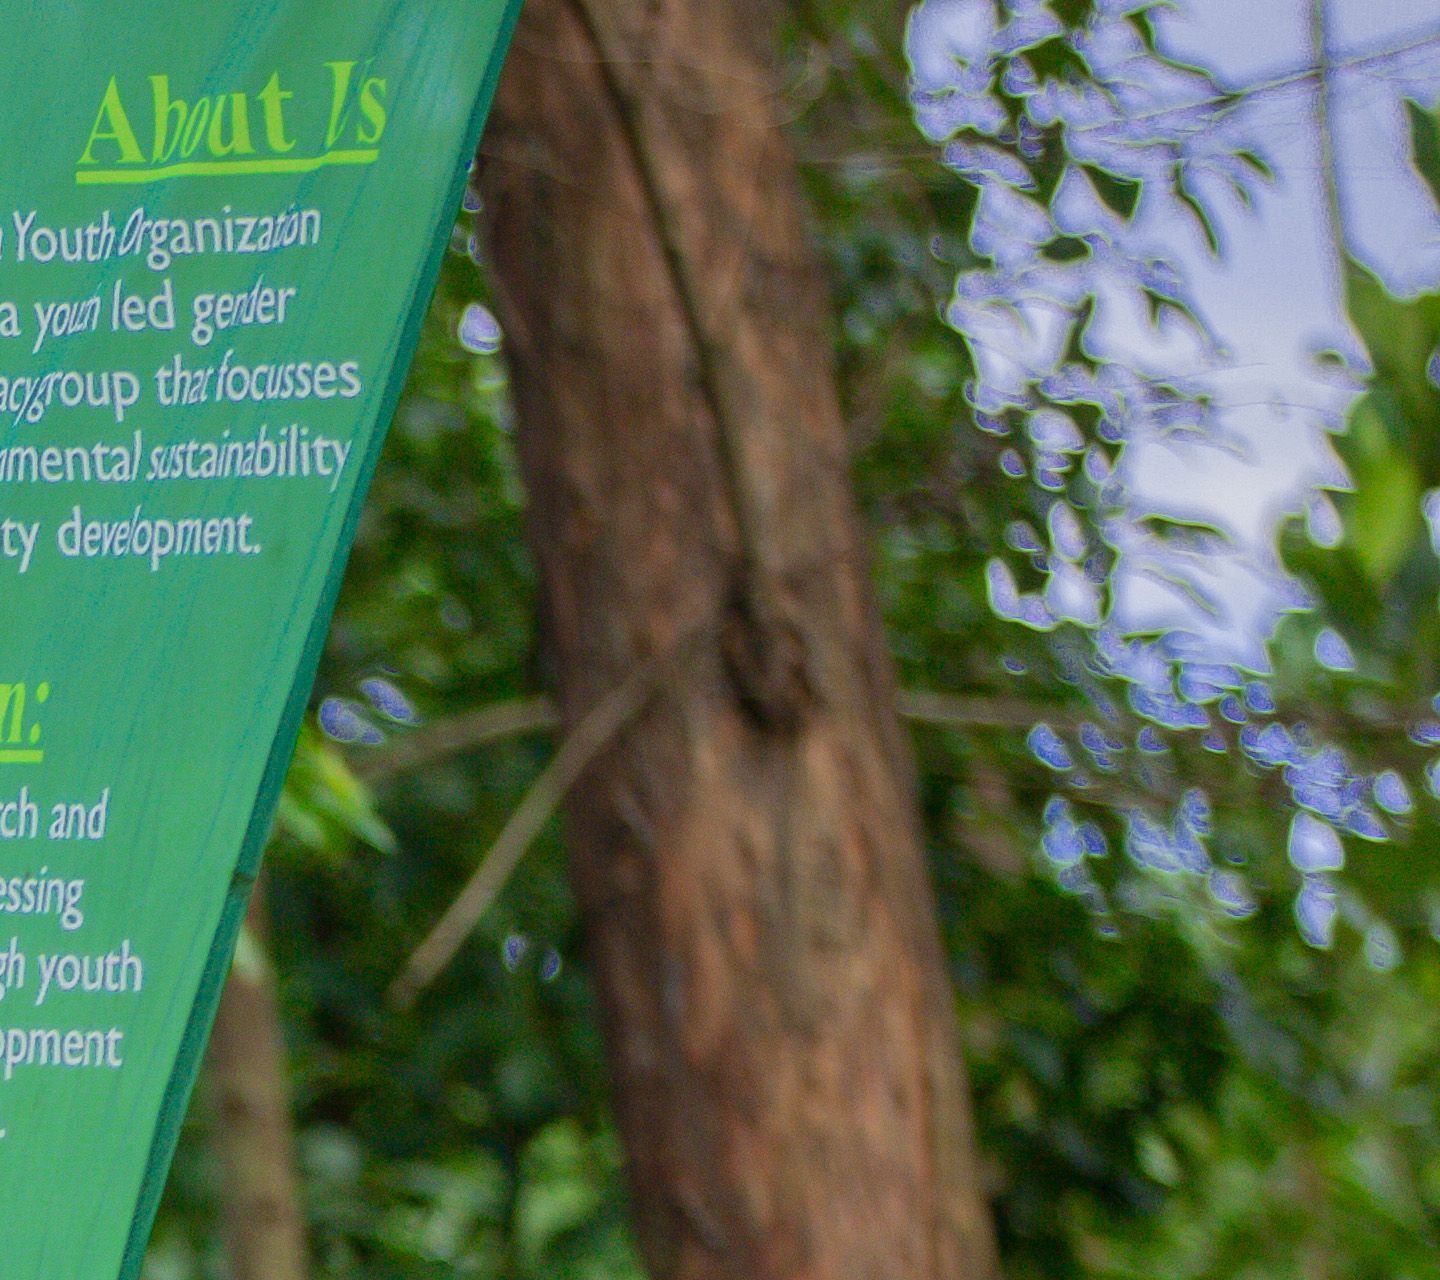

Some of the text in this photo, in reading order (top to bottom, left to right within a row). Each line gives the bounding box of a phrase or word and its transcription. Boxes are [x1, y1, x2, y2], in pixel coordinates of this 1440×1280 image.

[77, 70, 297, 164] About
[12, 210, 116, 262] Youth
[111, 278, 176, 331] led
[191, 274, 296, 346] gender
[26, 371, 140, 423] group
[215, 349, 361, 401] focusses
[145, 424, 352, 493] sustainability
[58, 505, 261, 572] development.
[48, 788, 111, 839] and
[35, 940, 143, 1005] youth
